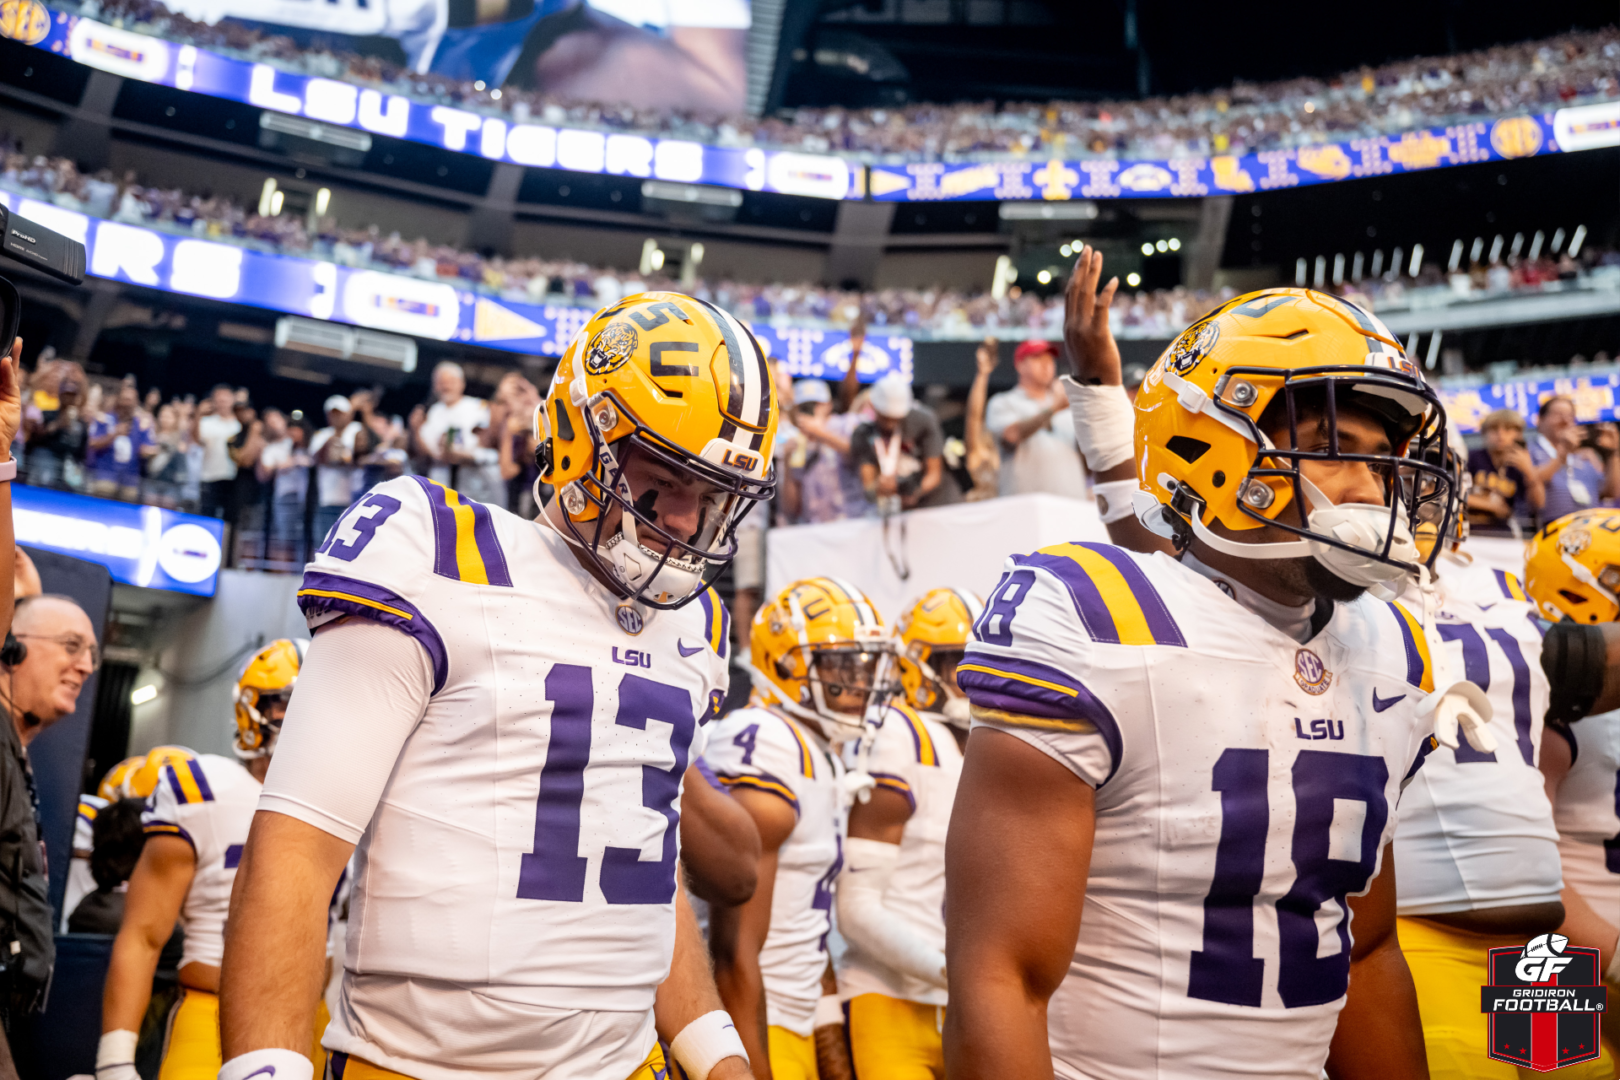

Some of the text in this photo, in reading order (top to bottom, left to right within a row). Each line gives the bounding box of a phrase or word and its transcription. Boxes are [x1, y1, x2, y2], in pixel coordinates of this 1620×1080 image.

[249, 63, 703, 182] LSU TIGERS
[11, 228, 37, 244] ProHD
[721, 448, 758, 472] LSU
[618, 606, 643, 633] SEC
[612, 646, 651, 668] LSU
[1297, 650, 1323, 683] SEC
[1300, 678, 1330, 694] GRADUATE
[1294, 717, 1344, 740] LSU
[733, 723, 760, 766] 4
[516, 663, 695, 904] 13
[1187, 748, 1389, 1009] 18
